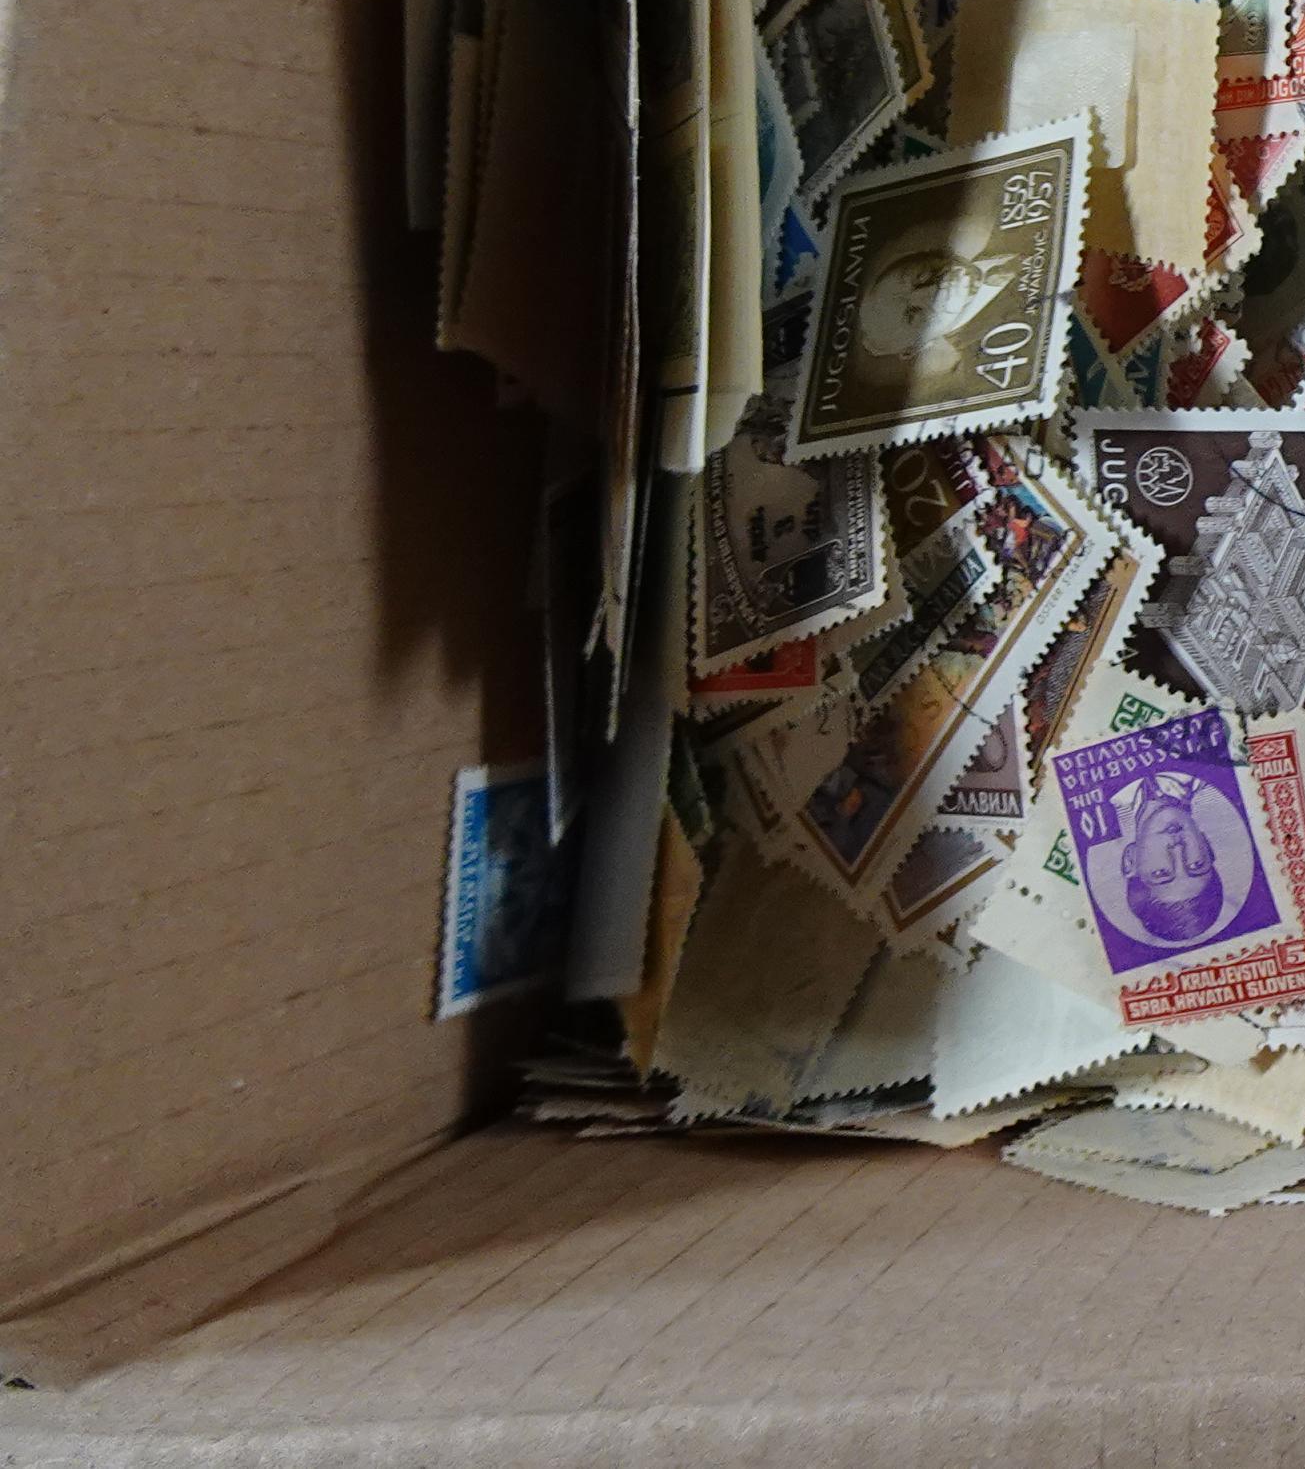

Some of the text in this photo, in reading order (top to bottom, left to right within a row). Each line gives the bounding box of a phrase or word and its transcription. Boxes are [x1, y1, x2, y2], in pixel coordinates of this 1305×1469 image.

[996, 170, 1031, 233] 1859
[1022, 168, 1055, 224] 1957
[818, 214, 872, 413] JUGOSLAVIJA
[969, 319, 1042, 392] 40
[1075, 803, 1112, 842] 10
[1178, 952, 1278, 993] KRALJEVSTVO
